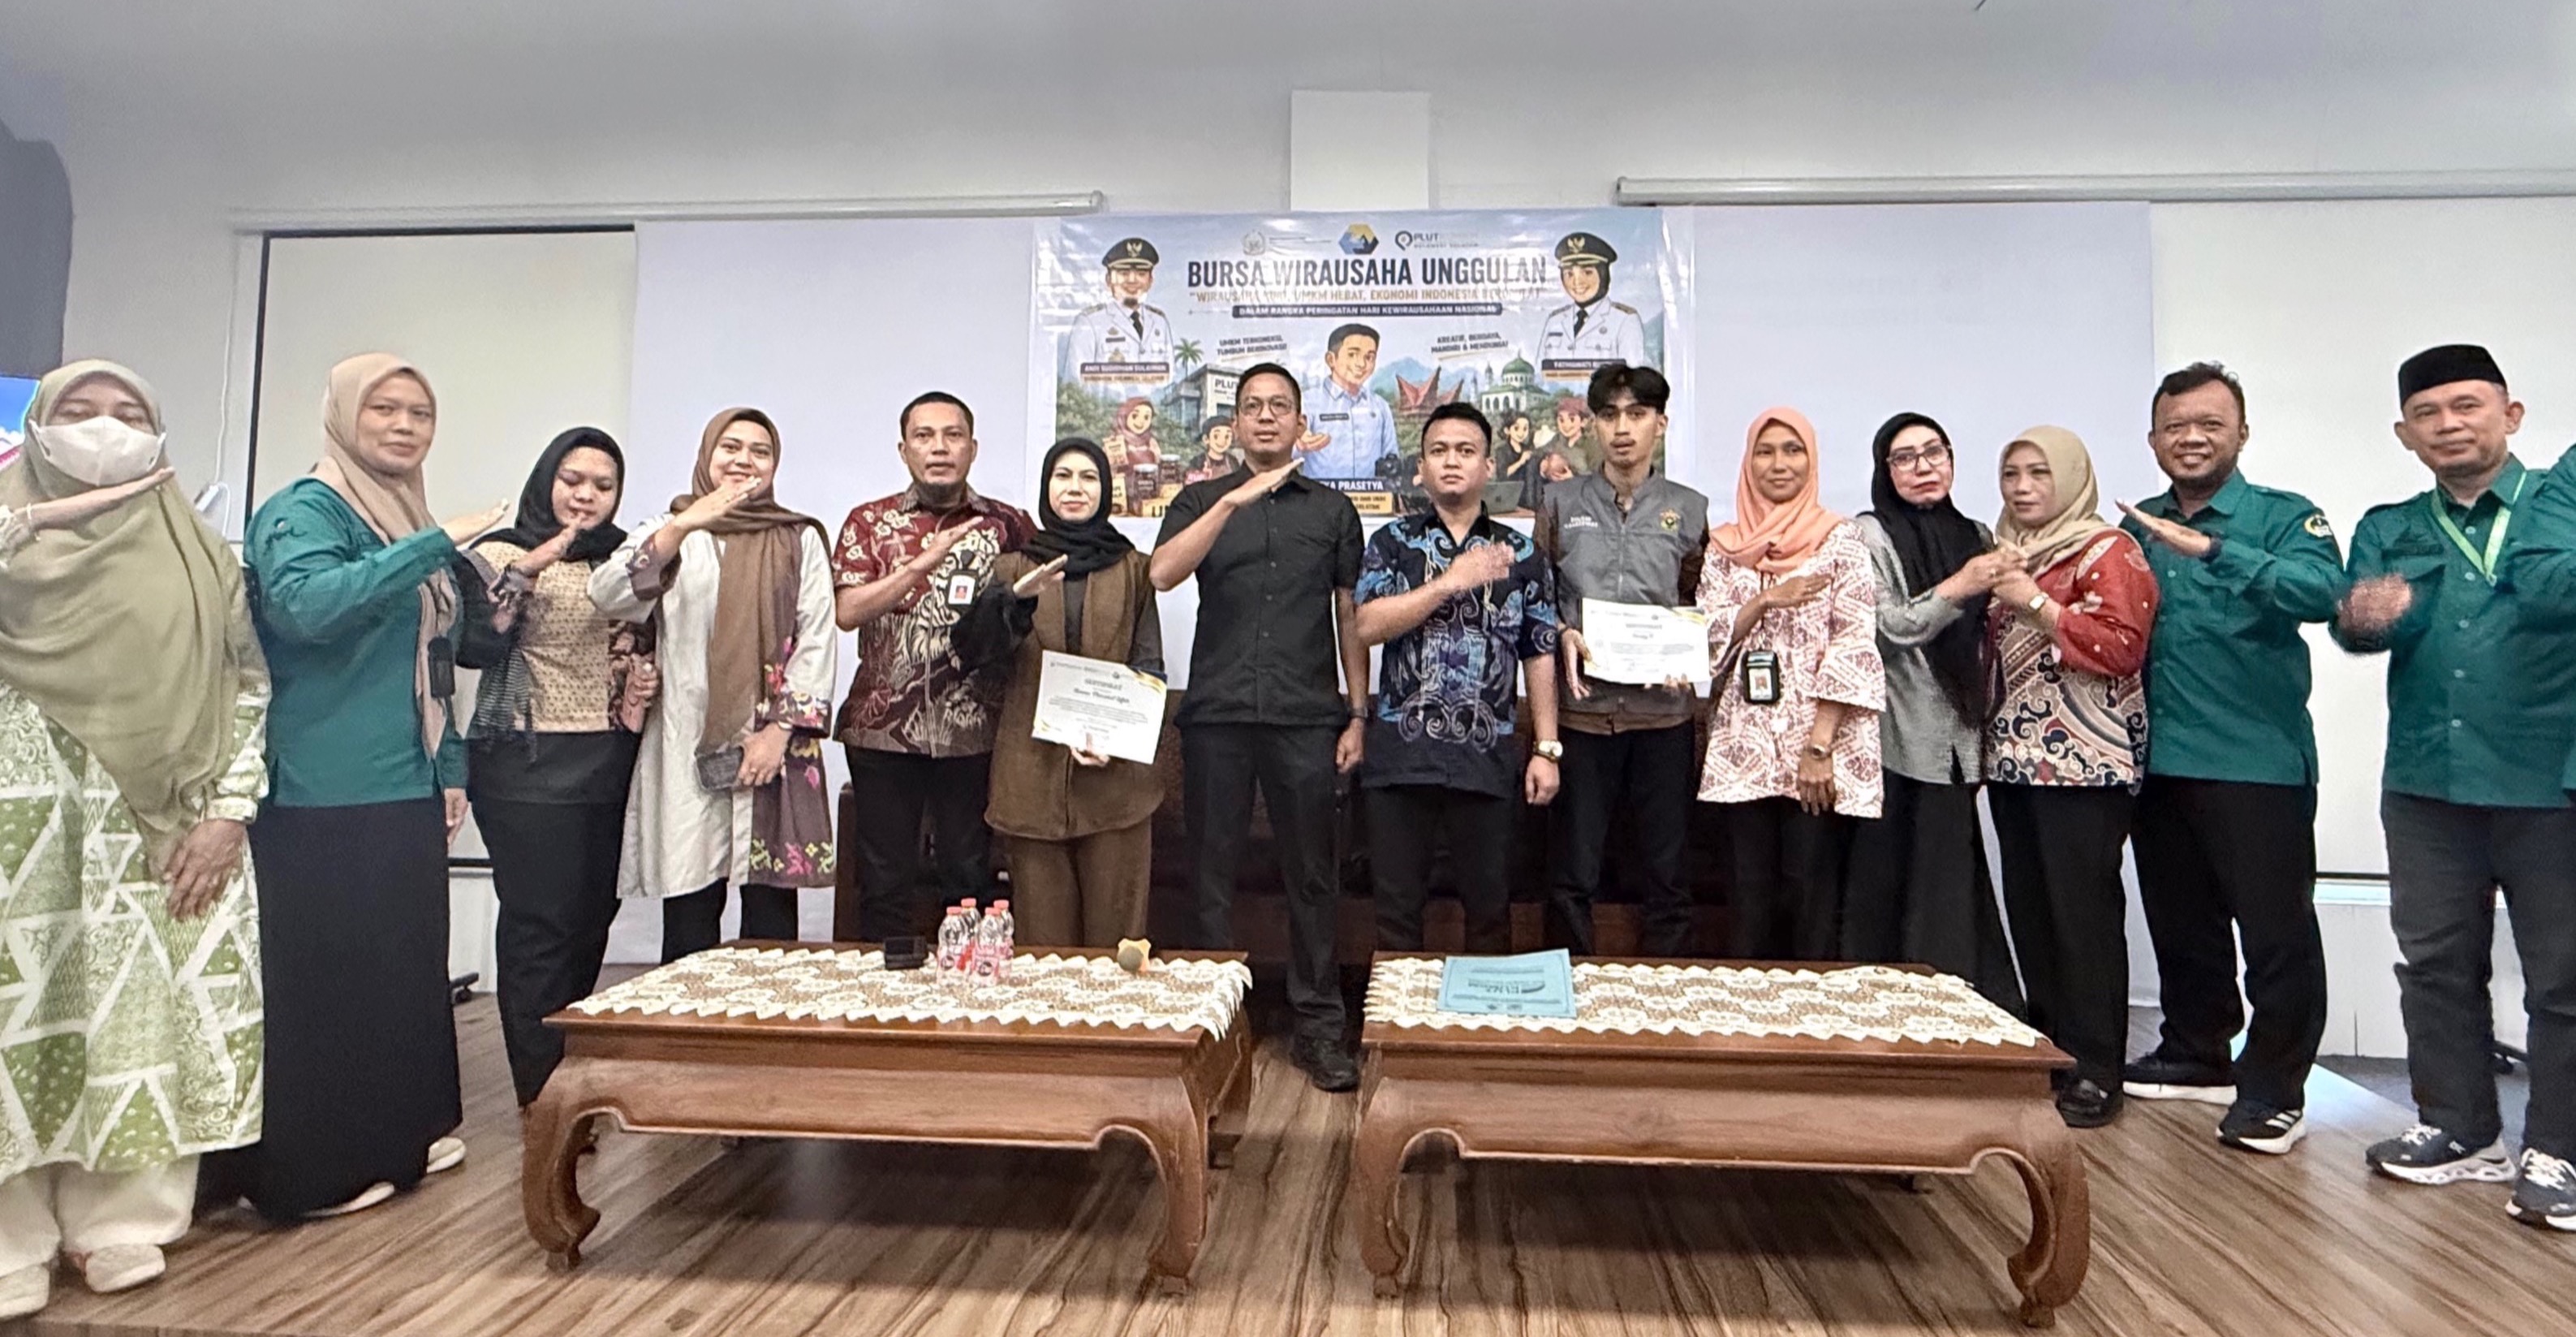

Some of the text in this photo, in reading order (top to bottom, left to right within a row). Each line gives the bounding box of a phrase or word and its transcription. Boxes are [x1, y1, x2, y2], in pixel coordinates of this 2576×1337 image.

[1414, 233, 1439, 241] PLUT
[1187, 256, 1547, 287] BURSA WIRAUSAHA UNGGULAN
[1331, 289, 1366, 301] HEBAT,
[1370, 288, 1418, 300] EKONOMI
[1422, 288, 1478, 300] INDONESIA
[1238, 304, 1497, 315] DALAM RANGKA PERINGATAN HARI KEWIRAUSAHAAN NASIONAL
[1338, 480, 1384, 490] PRASETYA
